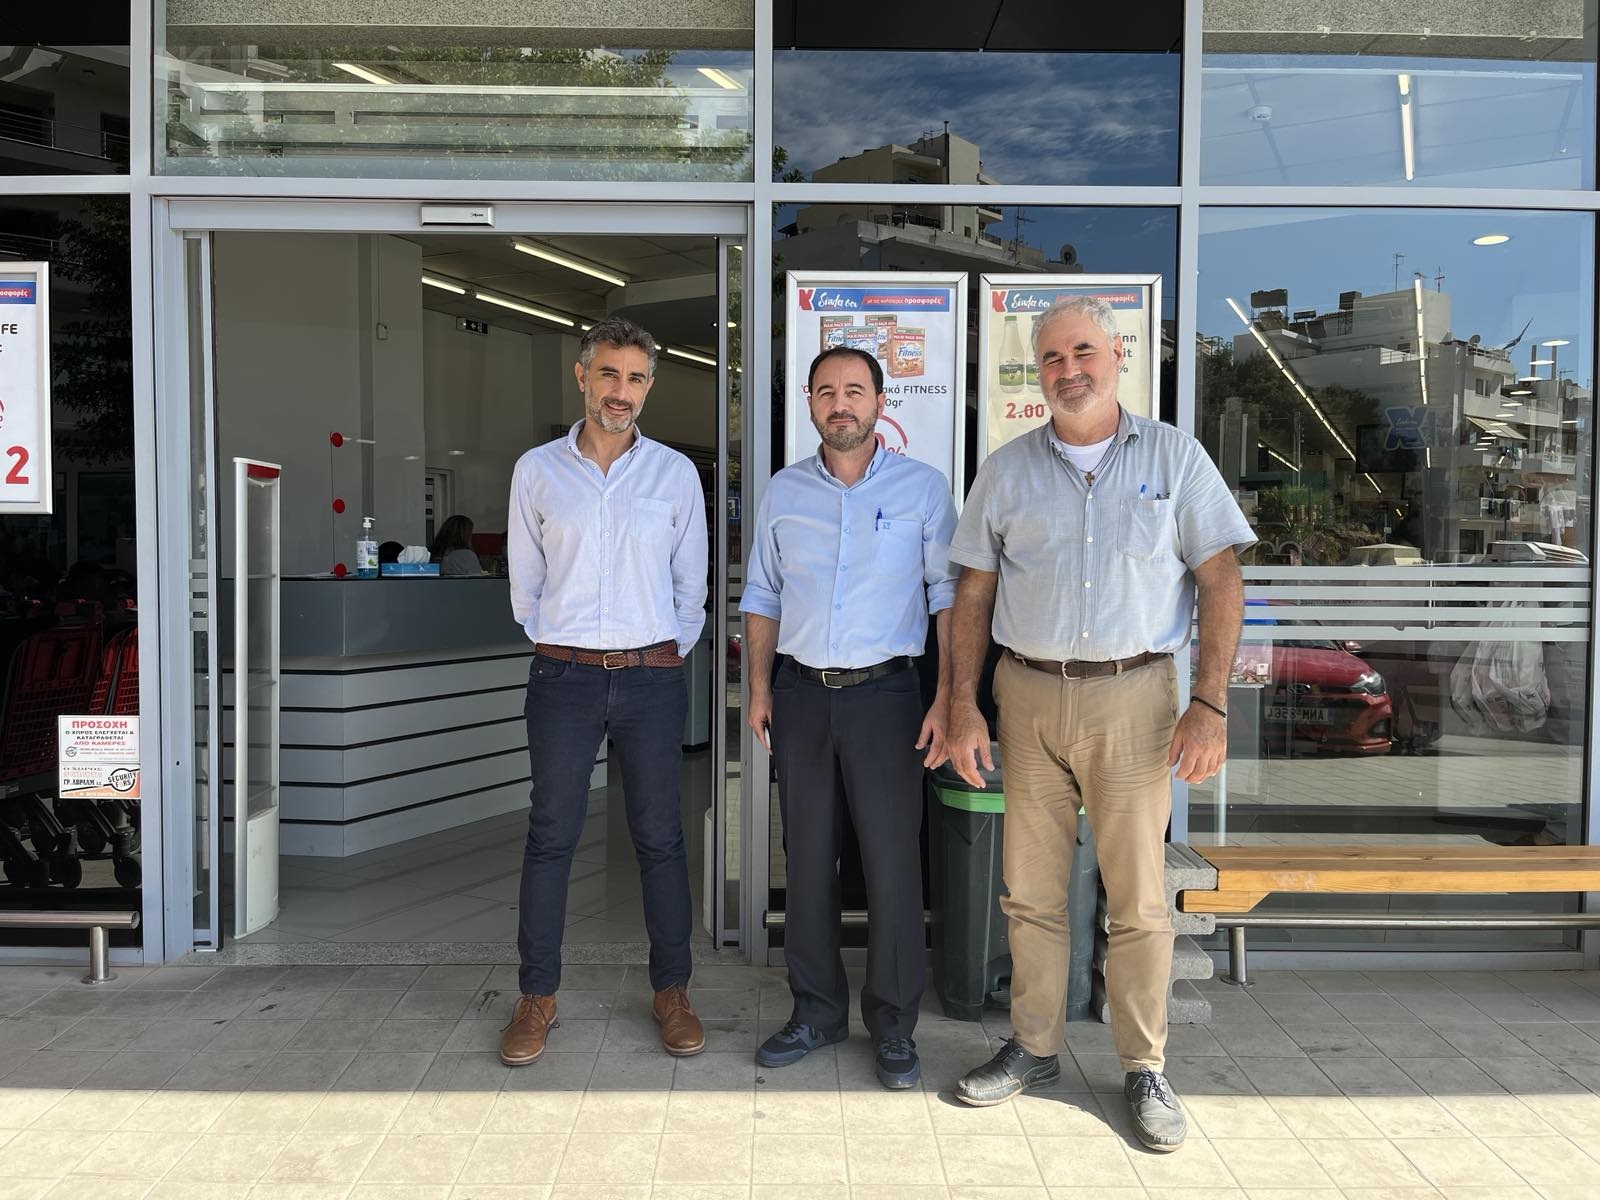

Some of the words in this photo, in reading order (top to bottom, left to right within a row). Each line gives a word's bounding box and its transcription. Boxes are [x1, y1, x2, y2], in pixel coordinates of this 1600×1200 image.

[904, 296, 942, 305] προσφορές
[1, 323, 18, 335] FE
[898, 346, 922, 357] Fitness
[904, 385, 948, 394] FITNESS
[1006, 402, 1044, 418] 2.00
[72, 721, 128, 729] ΠΡΟΣΟΧΗ
[107, 772, 137, 783] SECURITY
